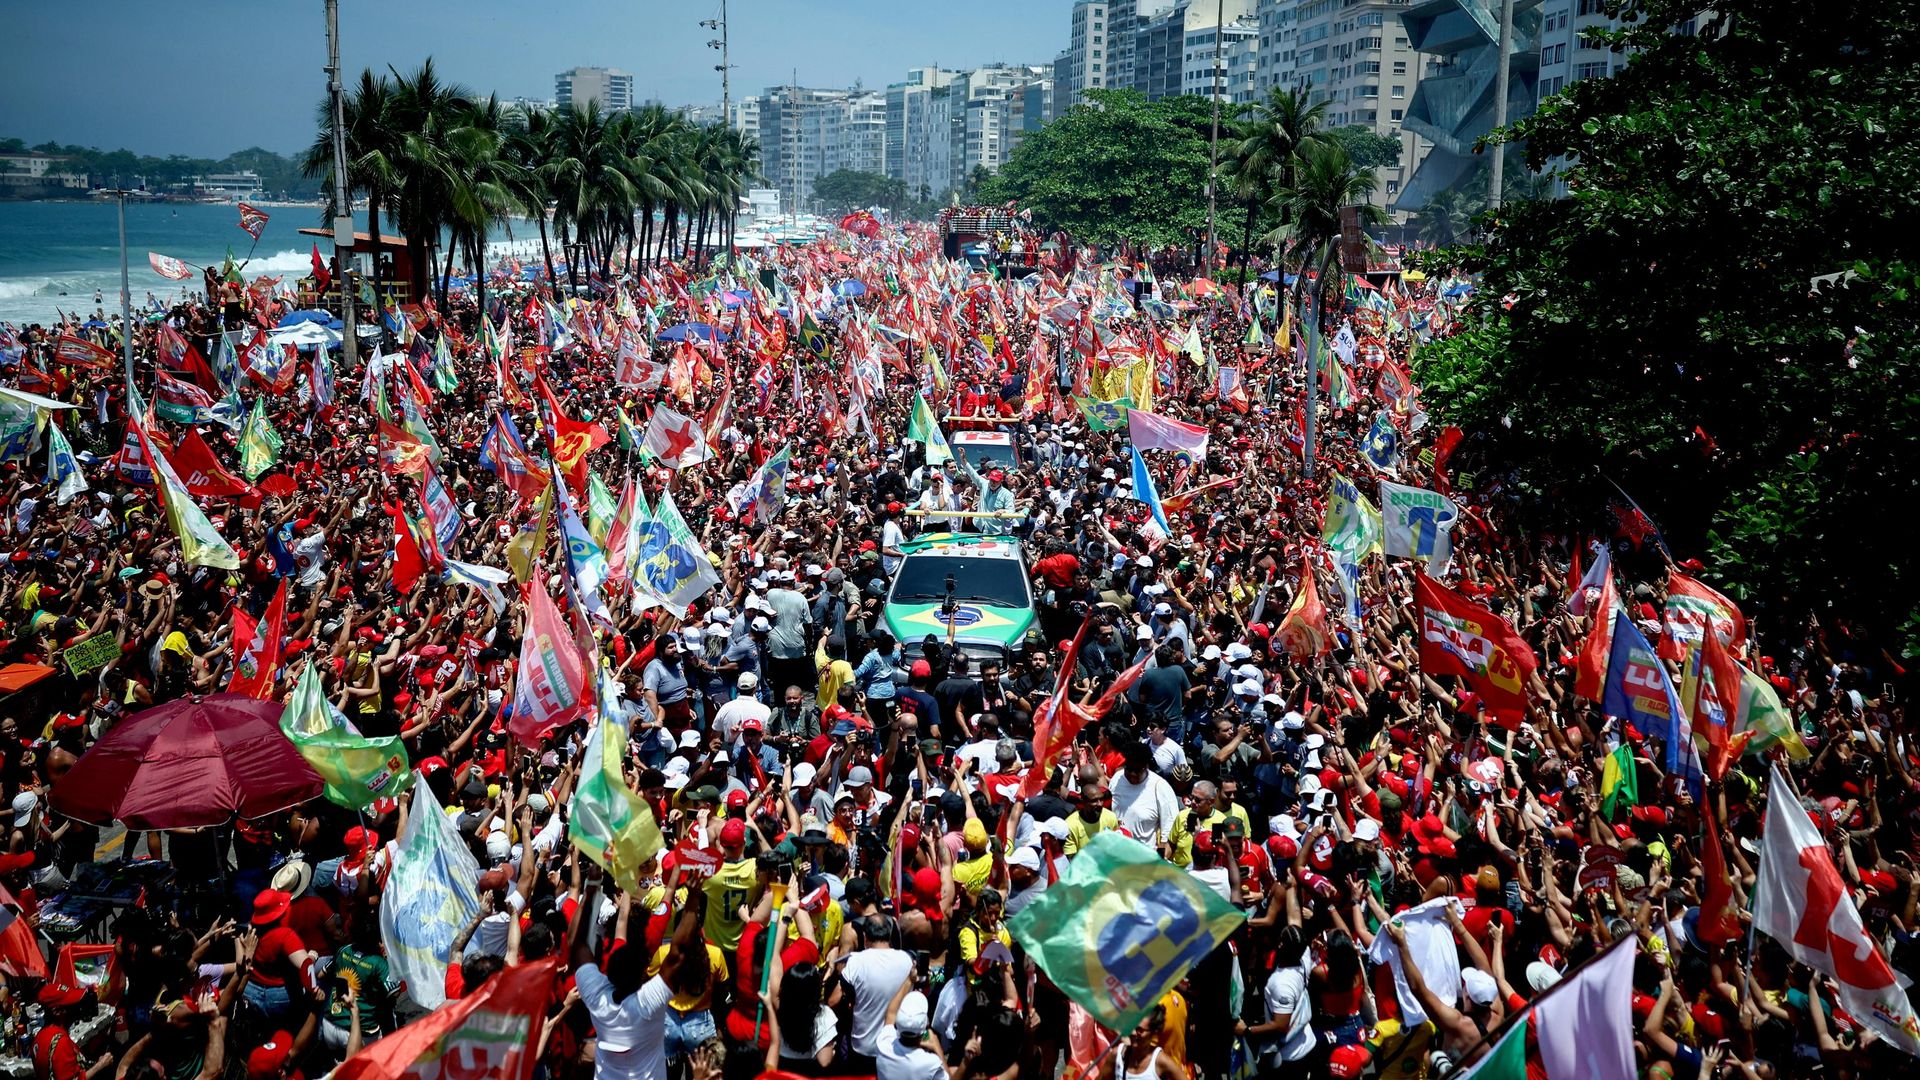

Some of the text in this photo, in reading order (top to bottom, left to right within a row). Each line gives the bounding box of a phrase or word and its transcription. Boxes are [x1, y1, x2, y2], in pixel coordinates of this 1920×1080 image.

[1339, 332, 1354, 349] SUS
[620, 357, 654, 384] 13
[1334, 478, 1358, 503] RIO
[1391, 492, 1444, 509] BRASIL
[1426, 619, 1484, 656] LULA
[436, 659, 458, 678] 13
[1490, 649, 1516, 680] 13
[368, 772, 389, 790] LULA
